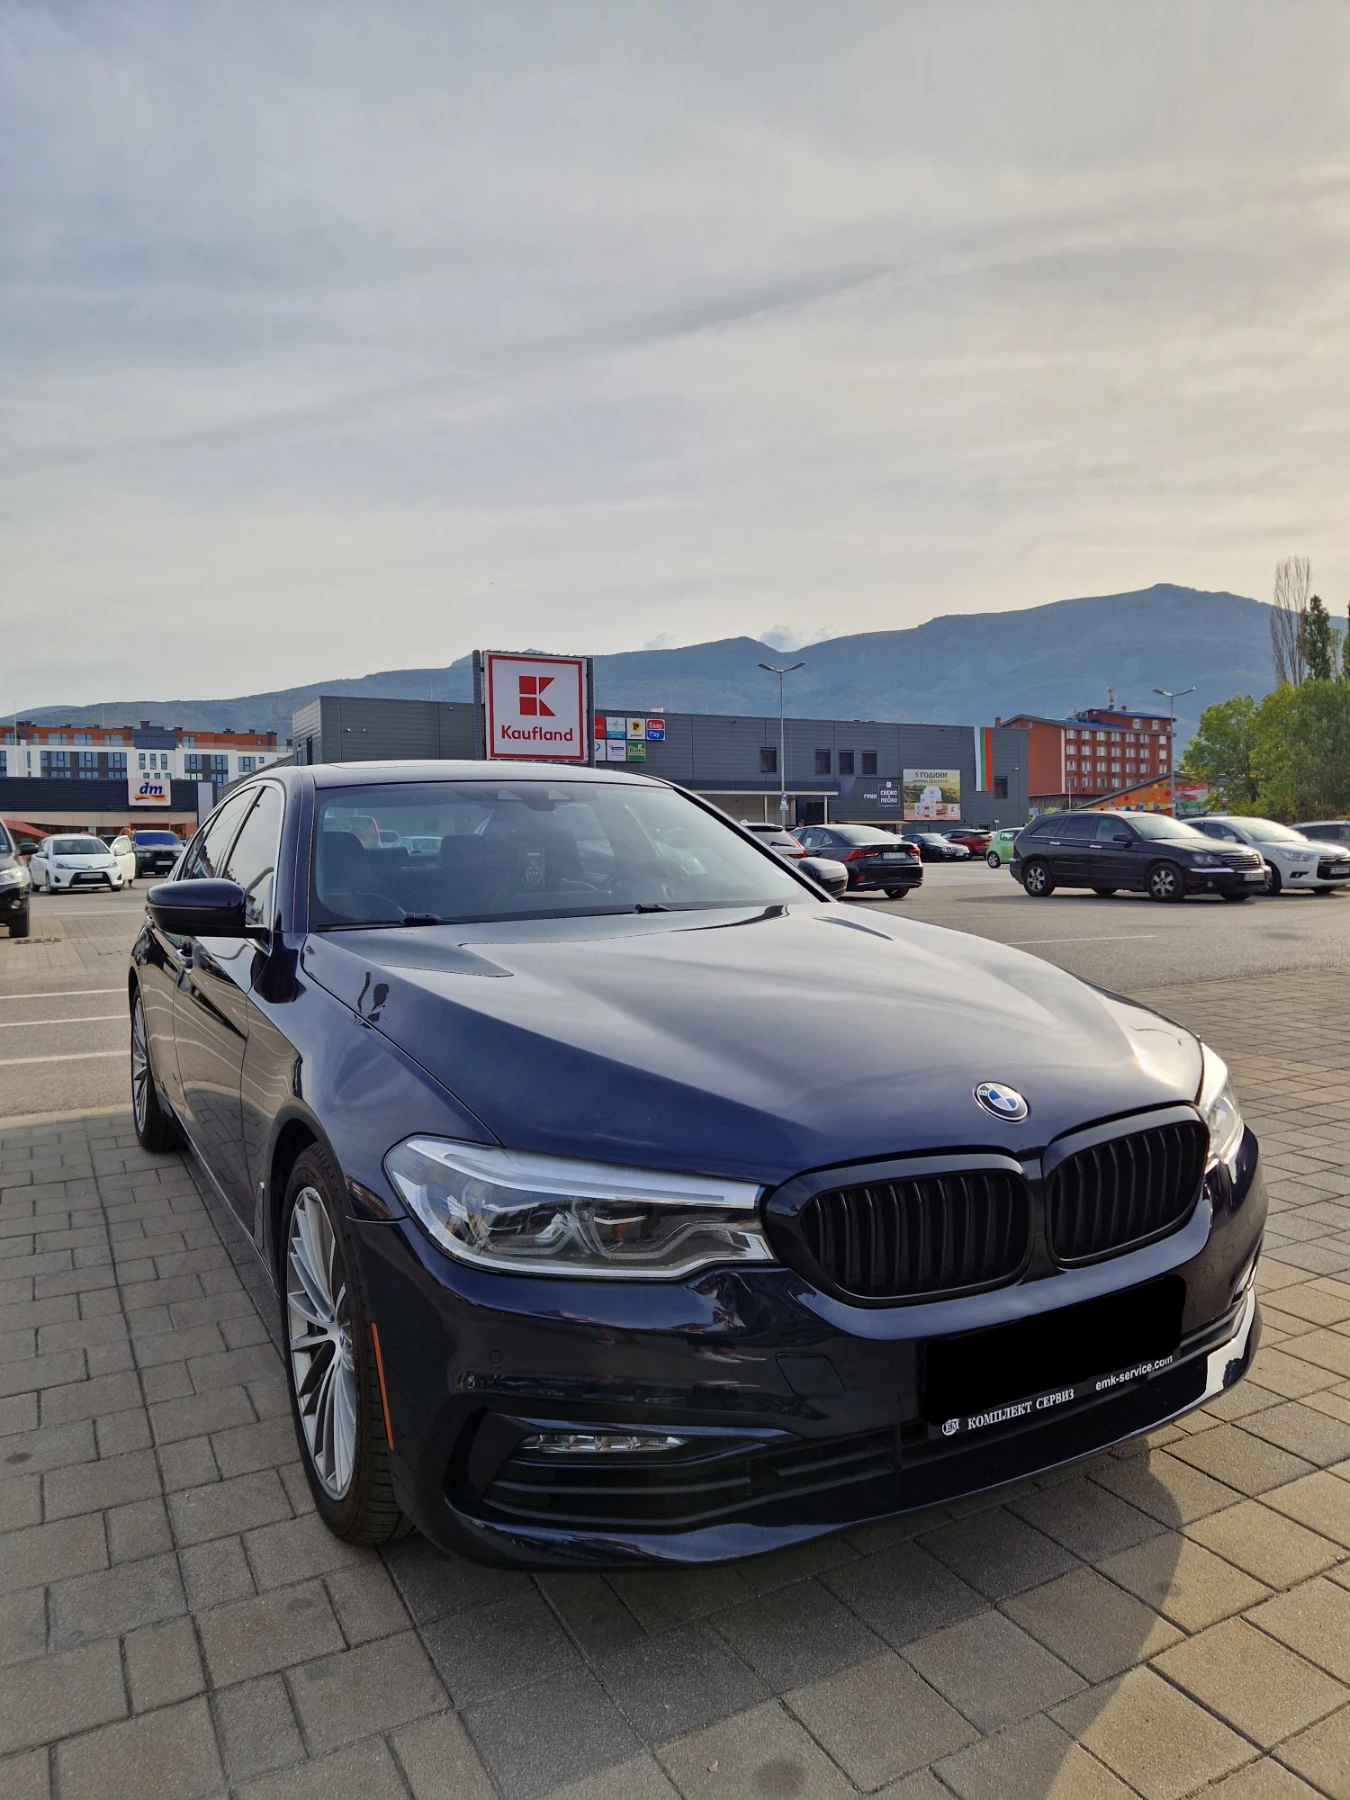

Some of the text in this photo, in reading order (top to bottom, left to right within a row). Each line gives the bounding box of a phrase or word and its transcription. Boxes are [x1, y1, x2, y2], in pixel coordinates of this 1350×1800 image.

[501, 725, 573, 741] Kaufland
[139, 782, 163, 795] dm
[1095, 1355, 1173, 1391] emk-service.com
[967, 1388, 1075, 1430] КОМПЛЕКТ СЕРВИЗ
